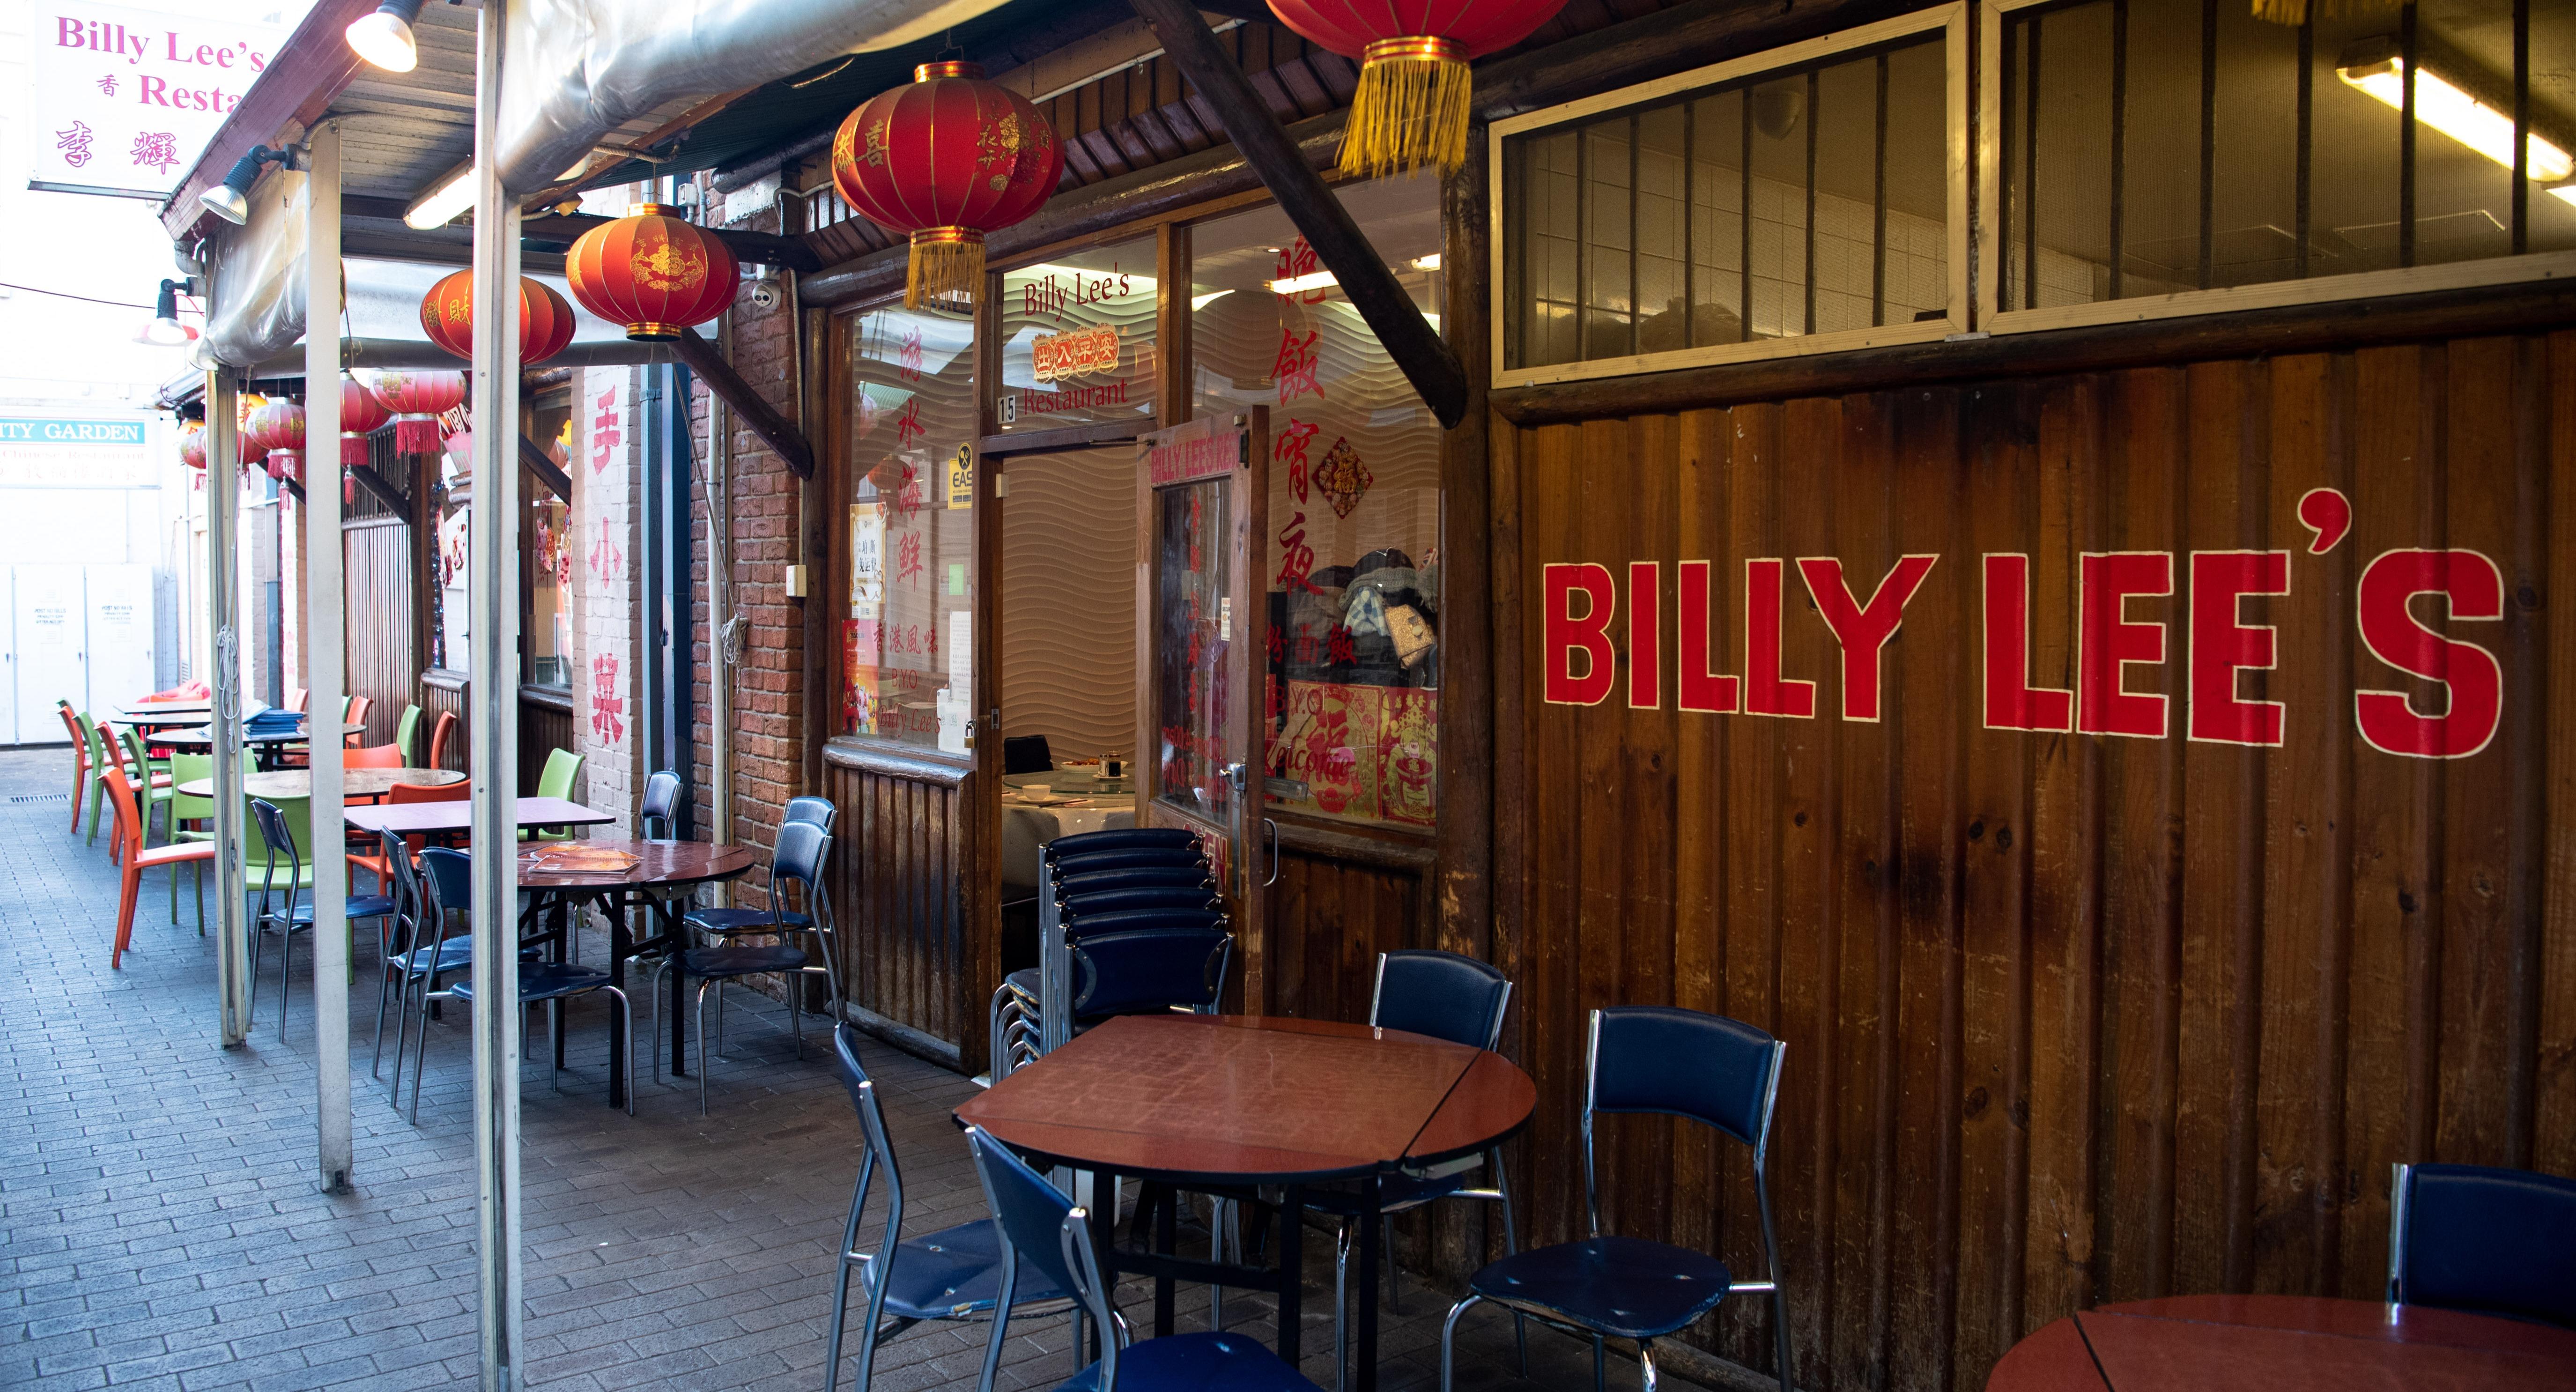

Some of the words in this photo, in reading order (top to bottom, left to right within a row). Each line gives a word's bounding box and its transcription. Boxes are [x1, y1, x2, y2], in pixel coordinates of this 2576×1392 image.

[55, 15, 150, 64] Billy
[164, 31, 265, 72] Lee's
[96, 74, 119, 97] 香
[1024, 274, 1068, 322] Billy
[1076, 262, 1130, 305] Lee's
[1036, 334, 1115, 369] 出入平安
[1000, 397, 1014, 422] 15
[1023, 378, 1128, 415] Restaurant
[1270, 231, 1326, 597] 晚飯宵夜
[44, 423, 139, 440] GARDEN
[1151, 443, 1182, 483] BILLY
[1185, 431, 1215, 478] LEE'S
[873, 622, 939, 655] 香港風味
[1542, 553, 1940, 723] BILLY
[1982, 487, 2505, 760] LEE'S
[892, 668, 918, 689] B.Y.O
[878, 703, 906, 739] Billy
